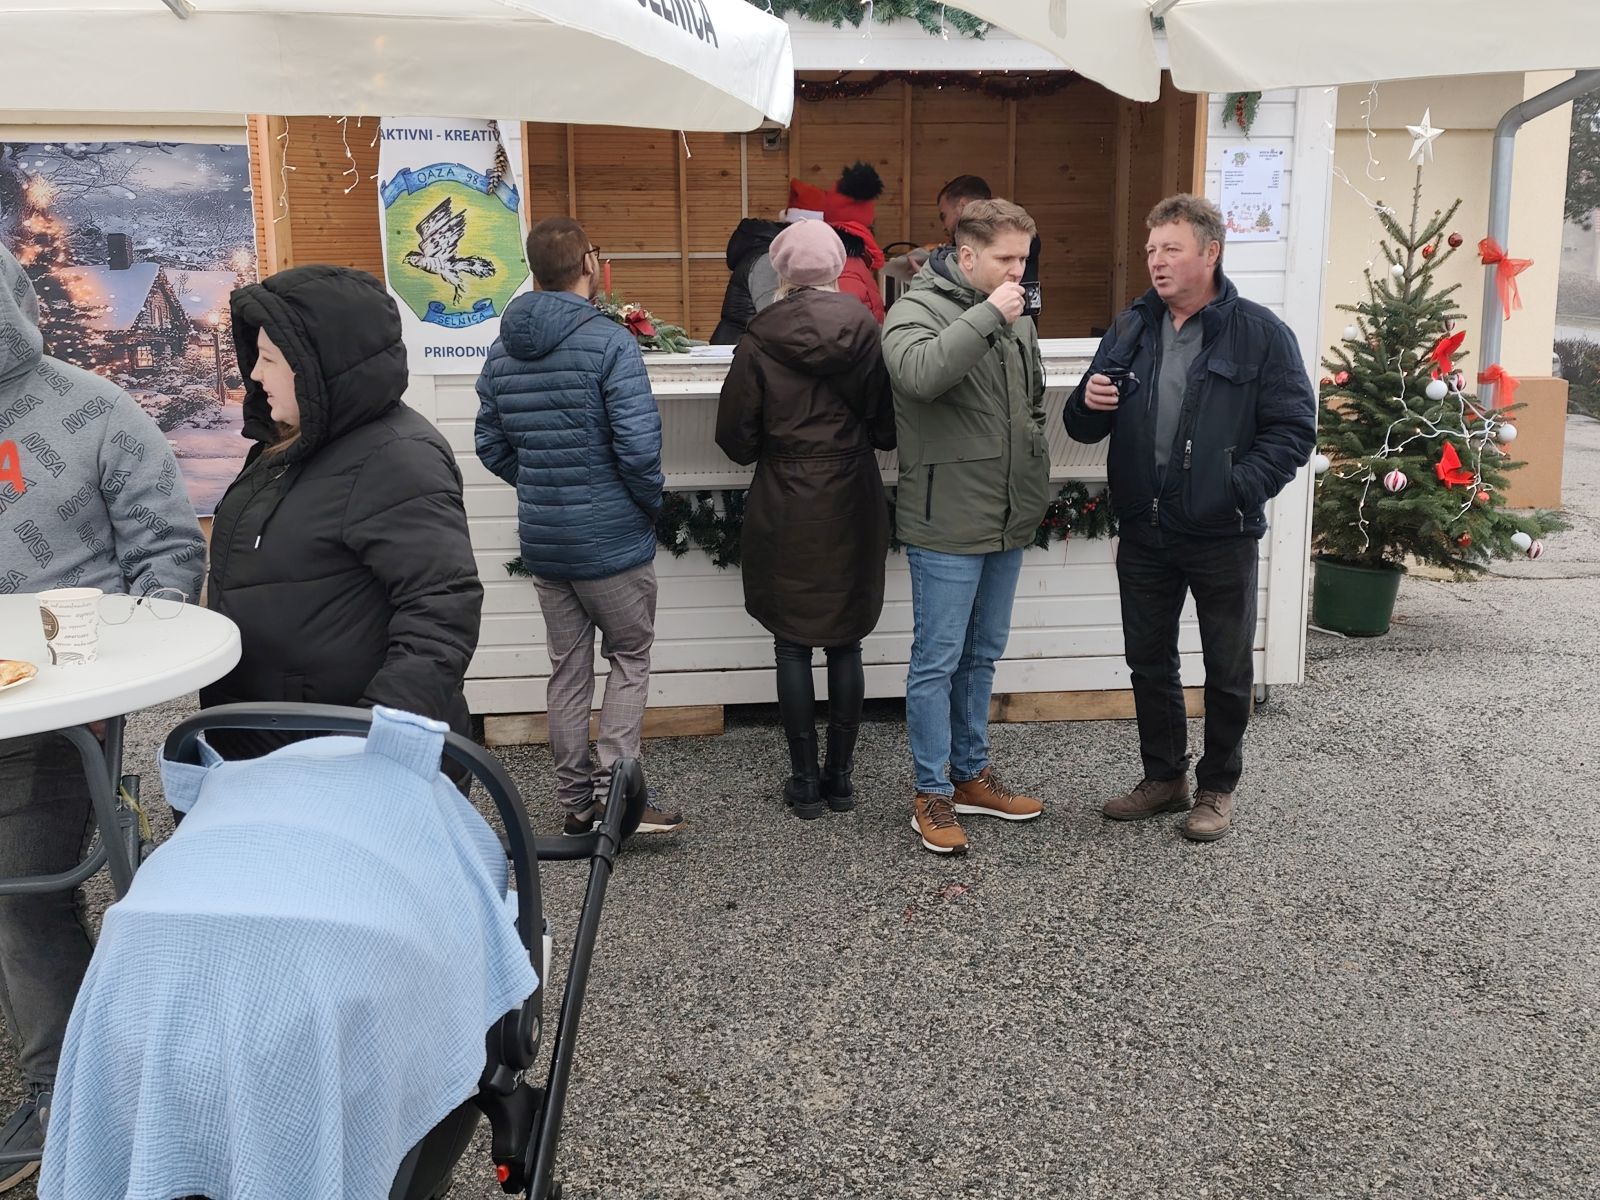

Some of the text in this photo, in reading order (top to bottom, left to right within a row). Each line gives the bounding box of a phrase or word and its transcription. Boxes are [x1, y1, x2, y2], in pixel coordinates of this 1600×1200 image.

[417, 168, 479, 185] OAZA 98
[437, 312, 487, 326] SELNICA
[62, 396, 114, 434] NASA
[21, 432, 67, 478] NASA
[57, 480, 97, 521] NASA
[128, 504, 175, 540] NASA
[14, 520, 53, 569] NASA
